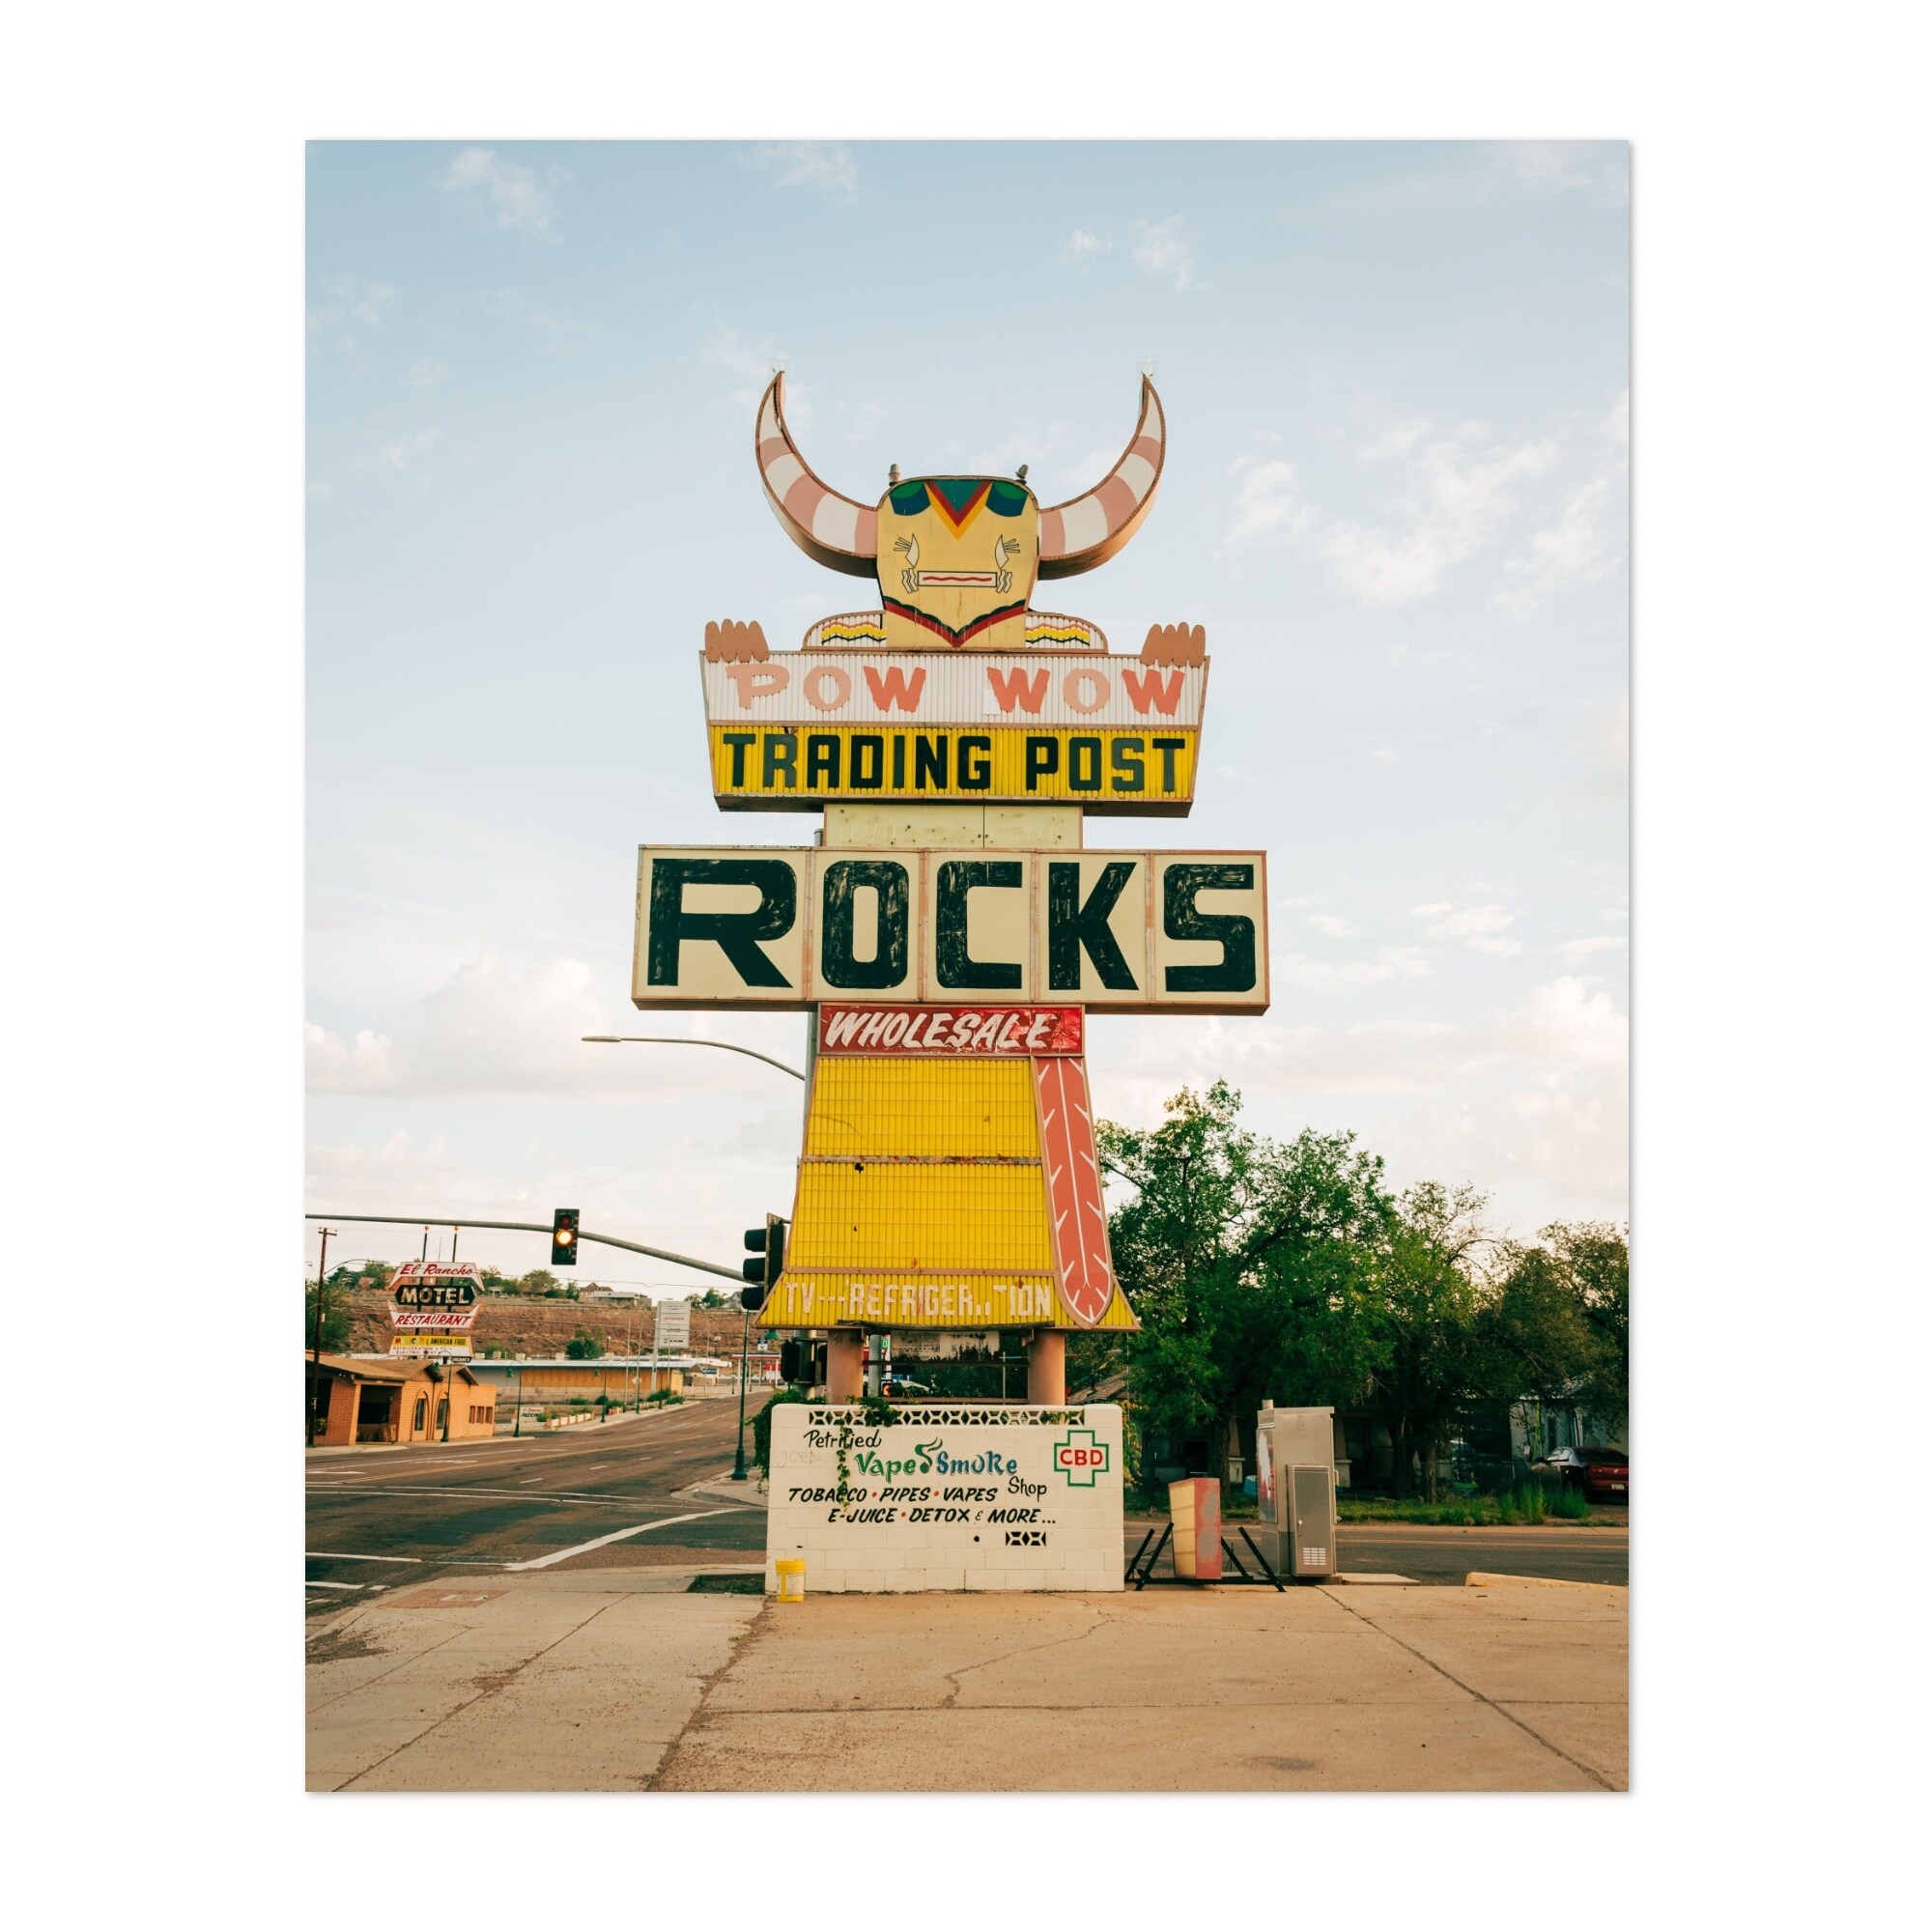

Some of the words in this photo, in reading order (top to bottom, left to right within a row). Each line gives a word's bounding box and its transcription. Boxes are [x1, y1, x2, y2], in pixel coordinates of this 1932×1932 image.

[725, 663, 926, 714] POW
[986, 666, 1185, 716] WOW
[723, 732, 992, 790] TRADING
[1026, 736, 1186, 792] POST
[647, 858, 1258, 993] ROCKS
[824, 1010, 1058, 1050] WHOLESALE
[400, 1264, 421, 1275] El
[423, 1264, 472, 1275] Rancho
[401, 1287, 469, 1304] MOTEL
[784, 1282, 815, 1314] TV
[395, 1315, 472, 1325] RESTAURANT
[854, 1450, 917, 1484] Vape
[1060, 1448, 1103, 1466] CBD
[879, 1488, 931, 1503] PIPES
[943, 1488, 998, 1502] VAPES
[1008, 1476, 1047, 1502] Shop
[828, 1508, 897, 1523] E-JUICE
[909, 1508, 970, 1523] DETOX
